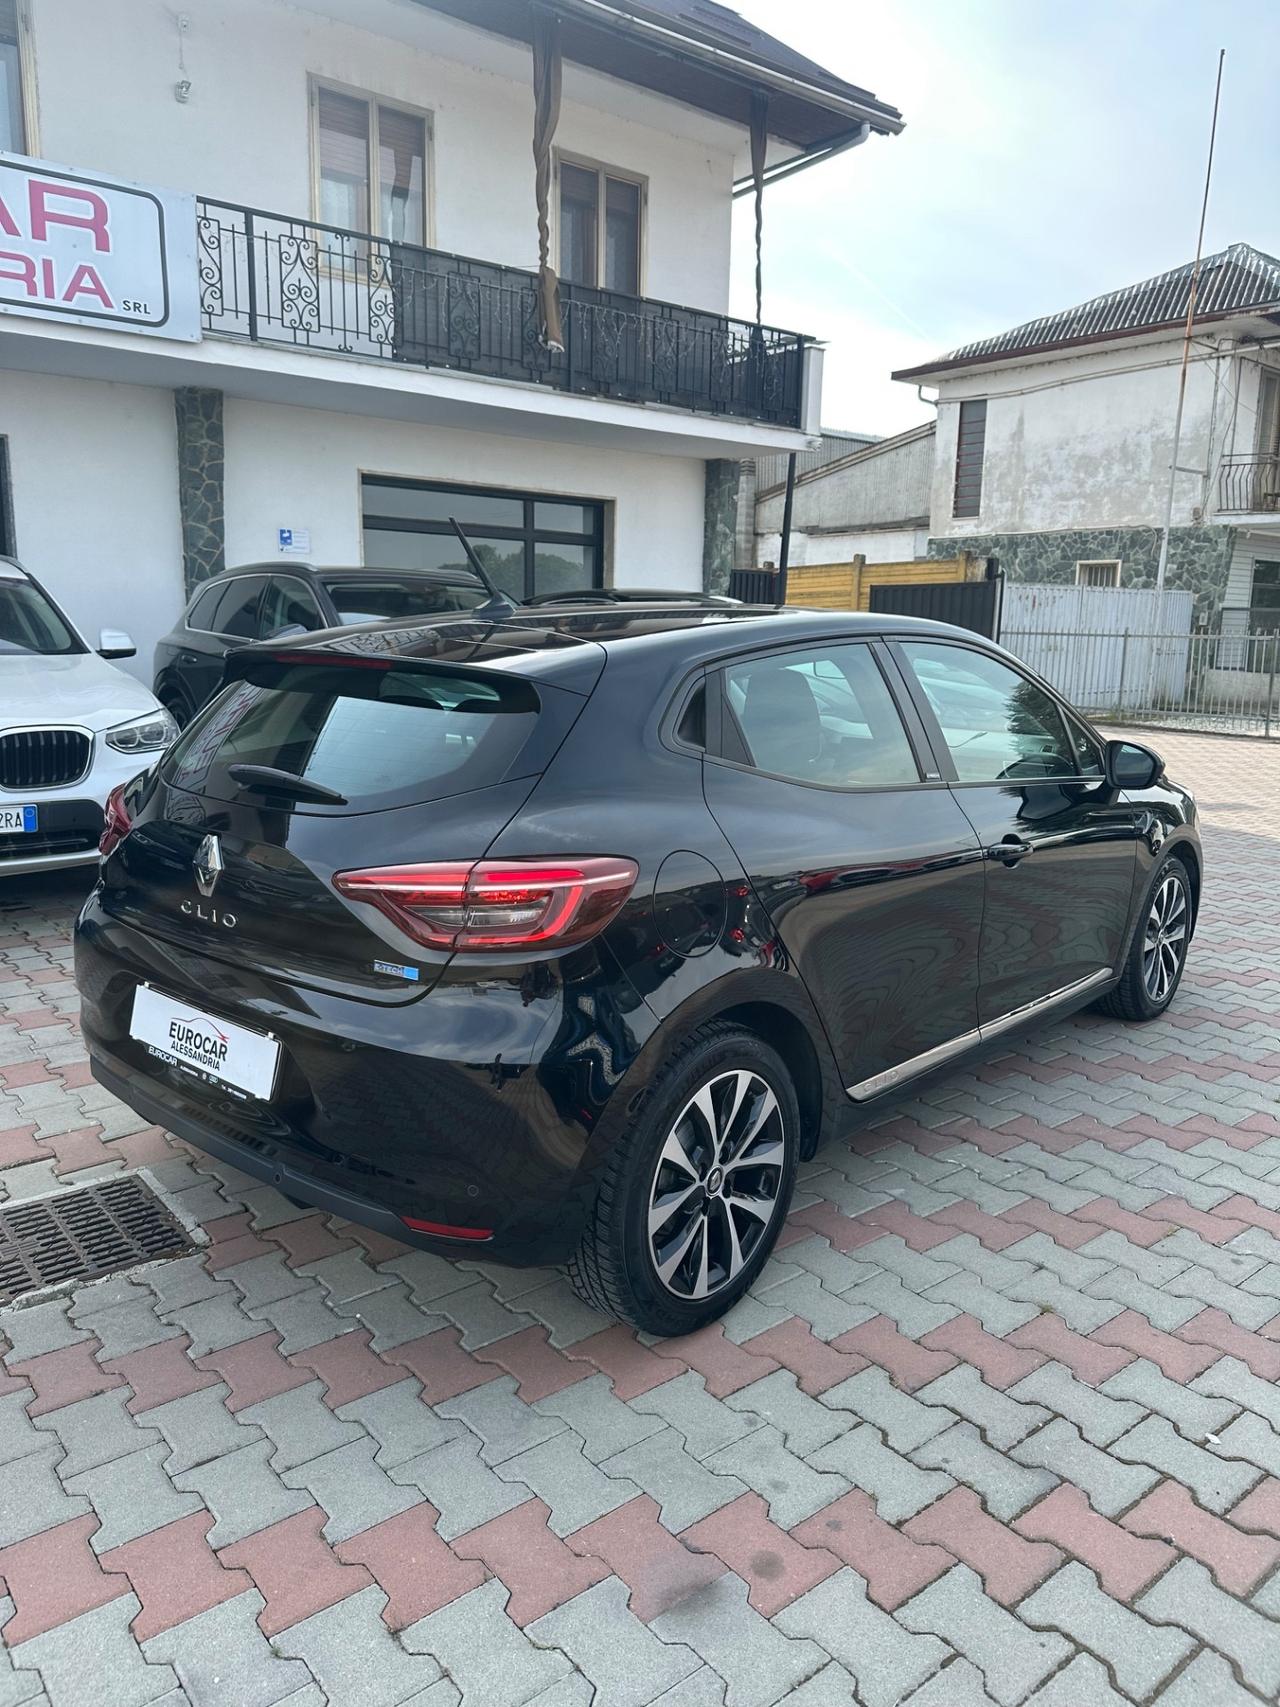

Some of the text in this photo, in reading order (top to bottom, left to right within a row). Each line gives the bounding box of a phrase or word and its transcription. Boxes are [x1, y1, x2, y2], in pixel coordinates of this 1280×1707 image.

[0, 252, 151, 315] RIA SRL
[180, 900, 237, 928] CLIO
[148, 1045, 178, 1067] EUROCAR
[168, 1021, 228, 1062] EUROCAR
[170, 1040, 221, 1072] ALESSANDRIA
